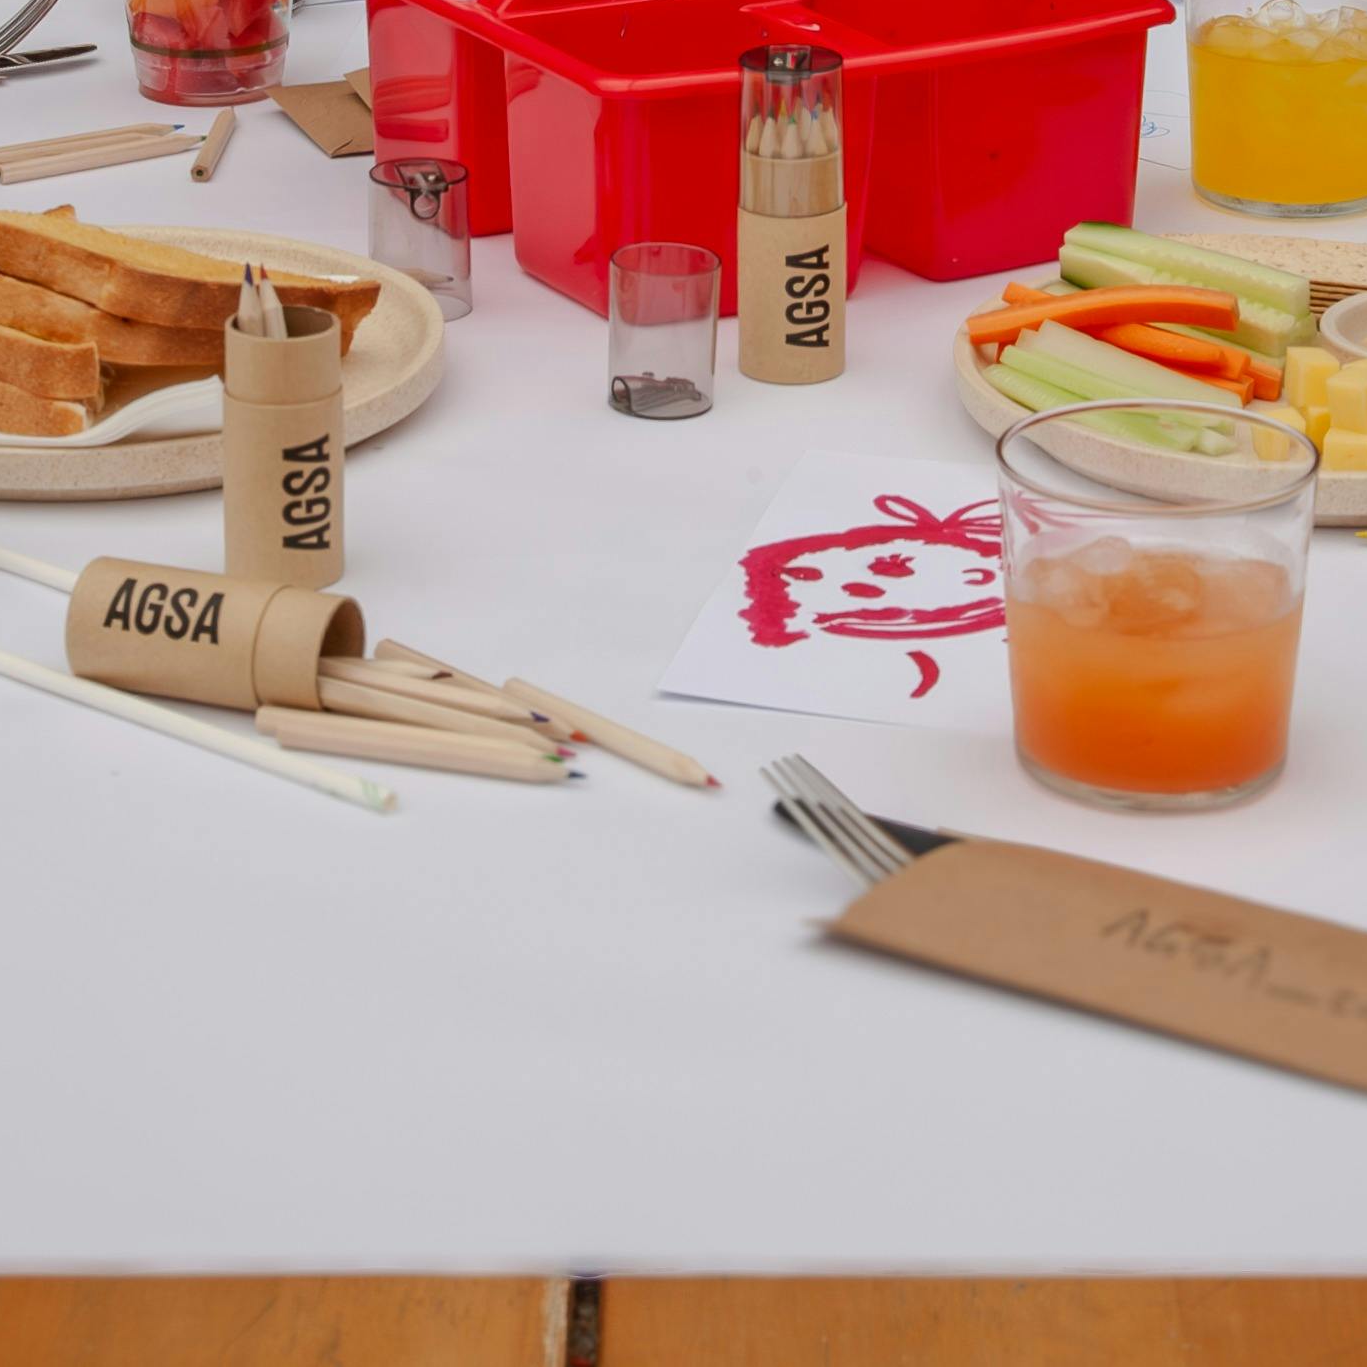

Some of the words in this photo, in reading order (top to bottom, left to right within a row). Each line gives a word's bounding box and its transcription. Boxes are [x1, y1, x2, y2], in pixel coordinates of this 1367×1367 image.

[785, 244, 830, 348] AGSA
[282, 433, 331, 550] AGSA
[103, 577, 225, 645] AGSA
